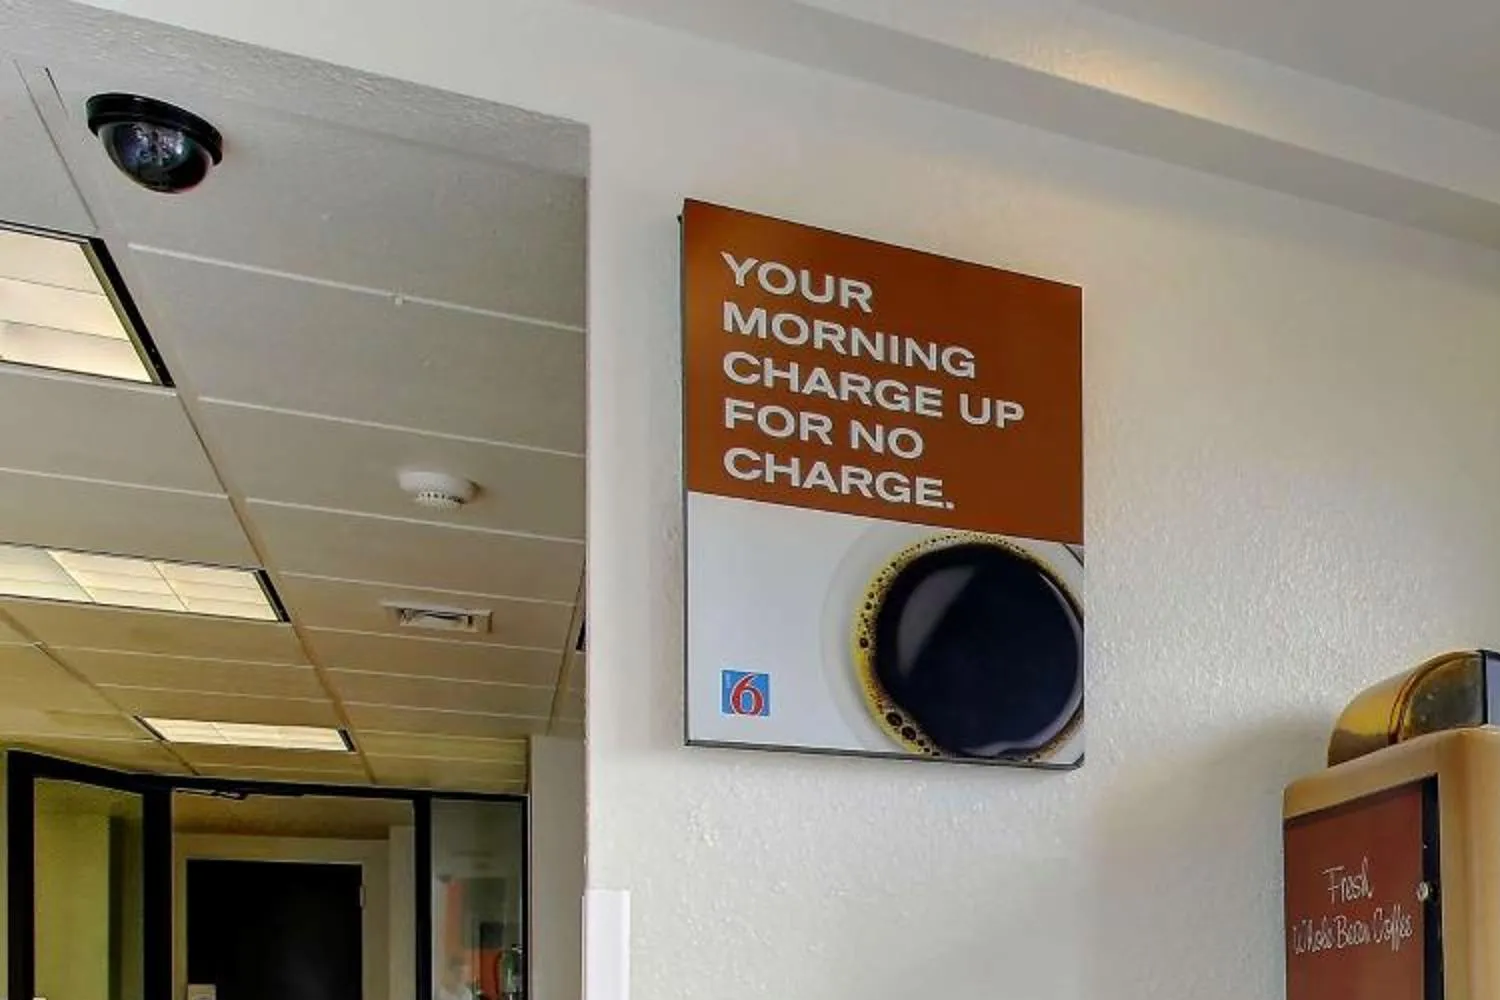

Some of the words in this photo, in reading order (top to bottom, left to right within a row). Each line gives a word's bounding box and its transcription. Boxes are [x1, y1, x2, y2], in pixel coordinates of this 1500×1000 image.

[721, 252, 873, 313] YOUR
[722, 301, 976, 379] MORNING
[722, 350, 944, 418] CHARGE
[959, 393, 1024, 429] UP
[724, 397, 834, 445] FOR
[850, 420, 924, 459] NO
[722, 447, 955, 510] CHARGE.
[730, 673, 764, 717] 6
[1322, 855, 1374, 904] Fresh
[1333, 915, 1371, 949] Bean
[1372, 903, 1414, 952] Coffee
